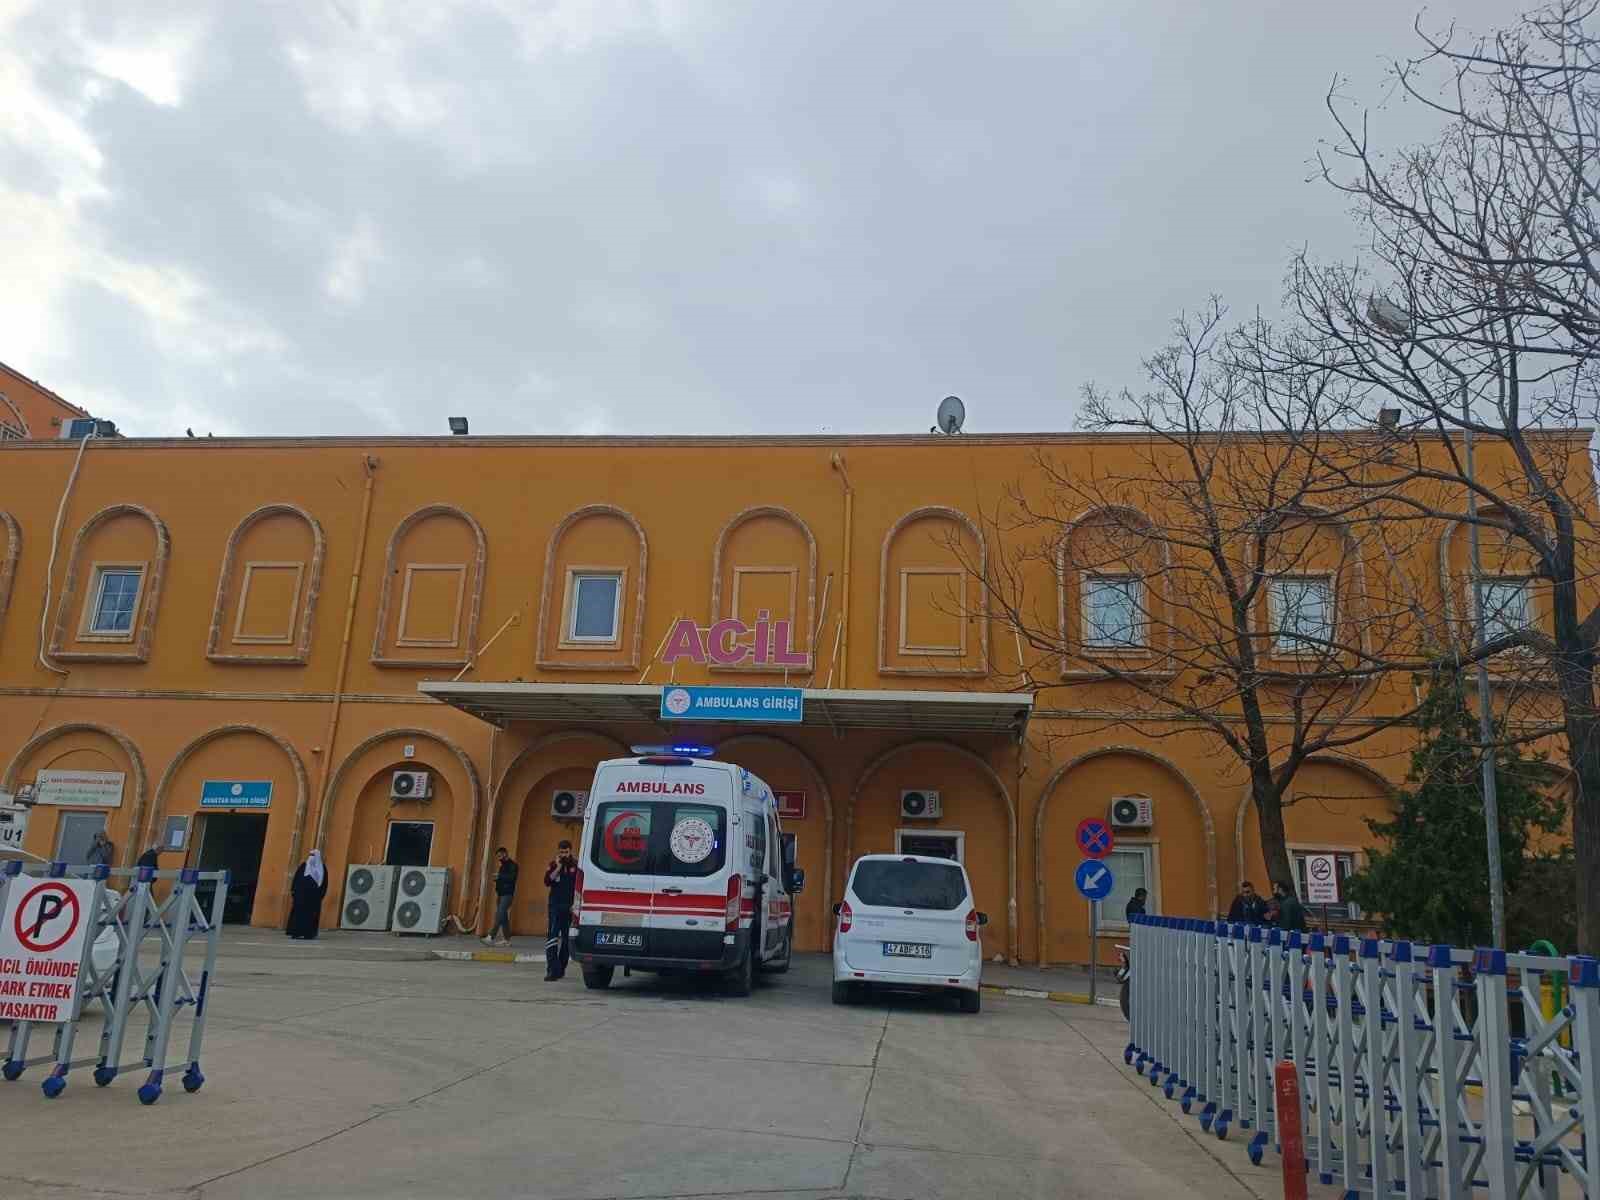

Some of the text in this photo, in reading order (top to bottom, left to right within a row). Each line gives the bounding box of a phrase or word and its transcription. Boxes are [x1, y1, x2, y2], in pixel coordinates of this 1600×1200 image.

[661, 608, 809, 665] ACİL
[695, 694, 798, 712] AMBULANS GİRİŞİ
[615, 781, 706, 795] AMBULANS
[25, 956, 78, 978] ÖNÜNDE
[0, 980, 72, 1000] ARK ETMEK
[0, 1001, 58, 1020] YASAKTIR
